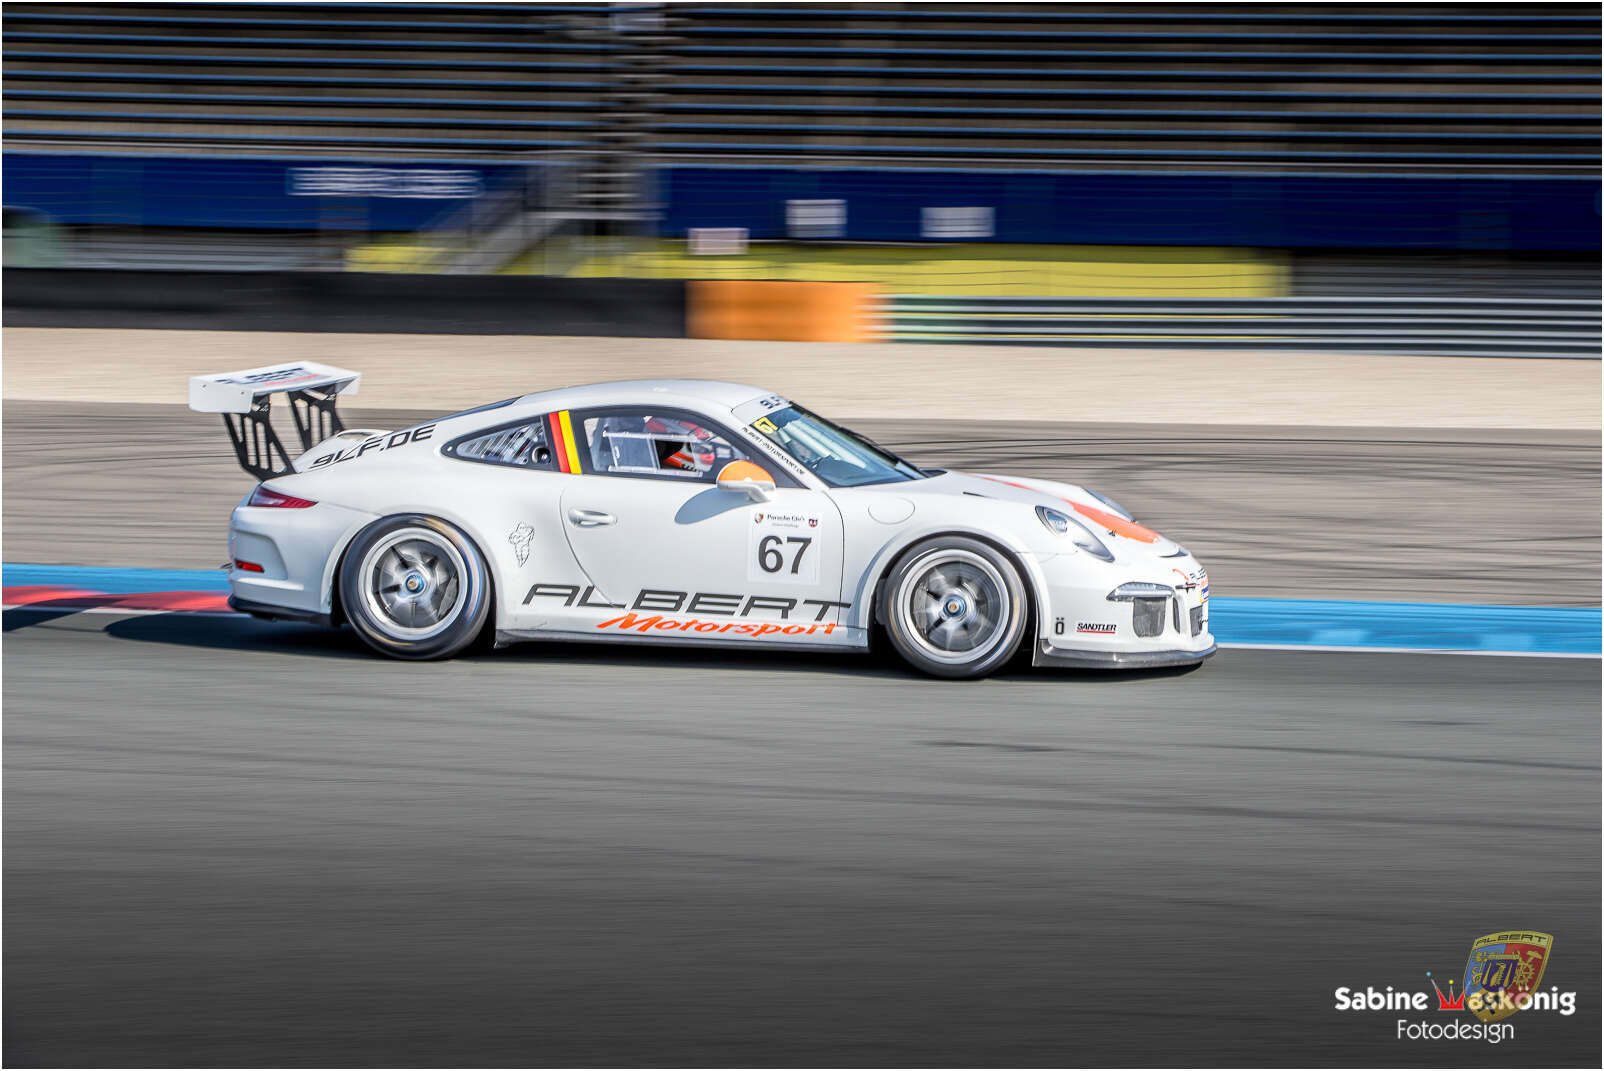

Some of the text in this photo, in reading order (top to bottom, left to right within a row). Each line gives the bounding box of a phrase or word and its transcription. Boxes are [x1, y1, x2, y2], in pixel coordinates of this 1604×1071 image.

[758, 535, 812, 575] 67
[522, 583, 851, 621] ALBERT
[597, 612, 840, 637] Motorsport
